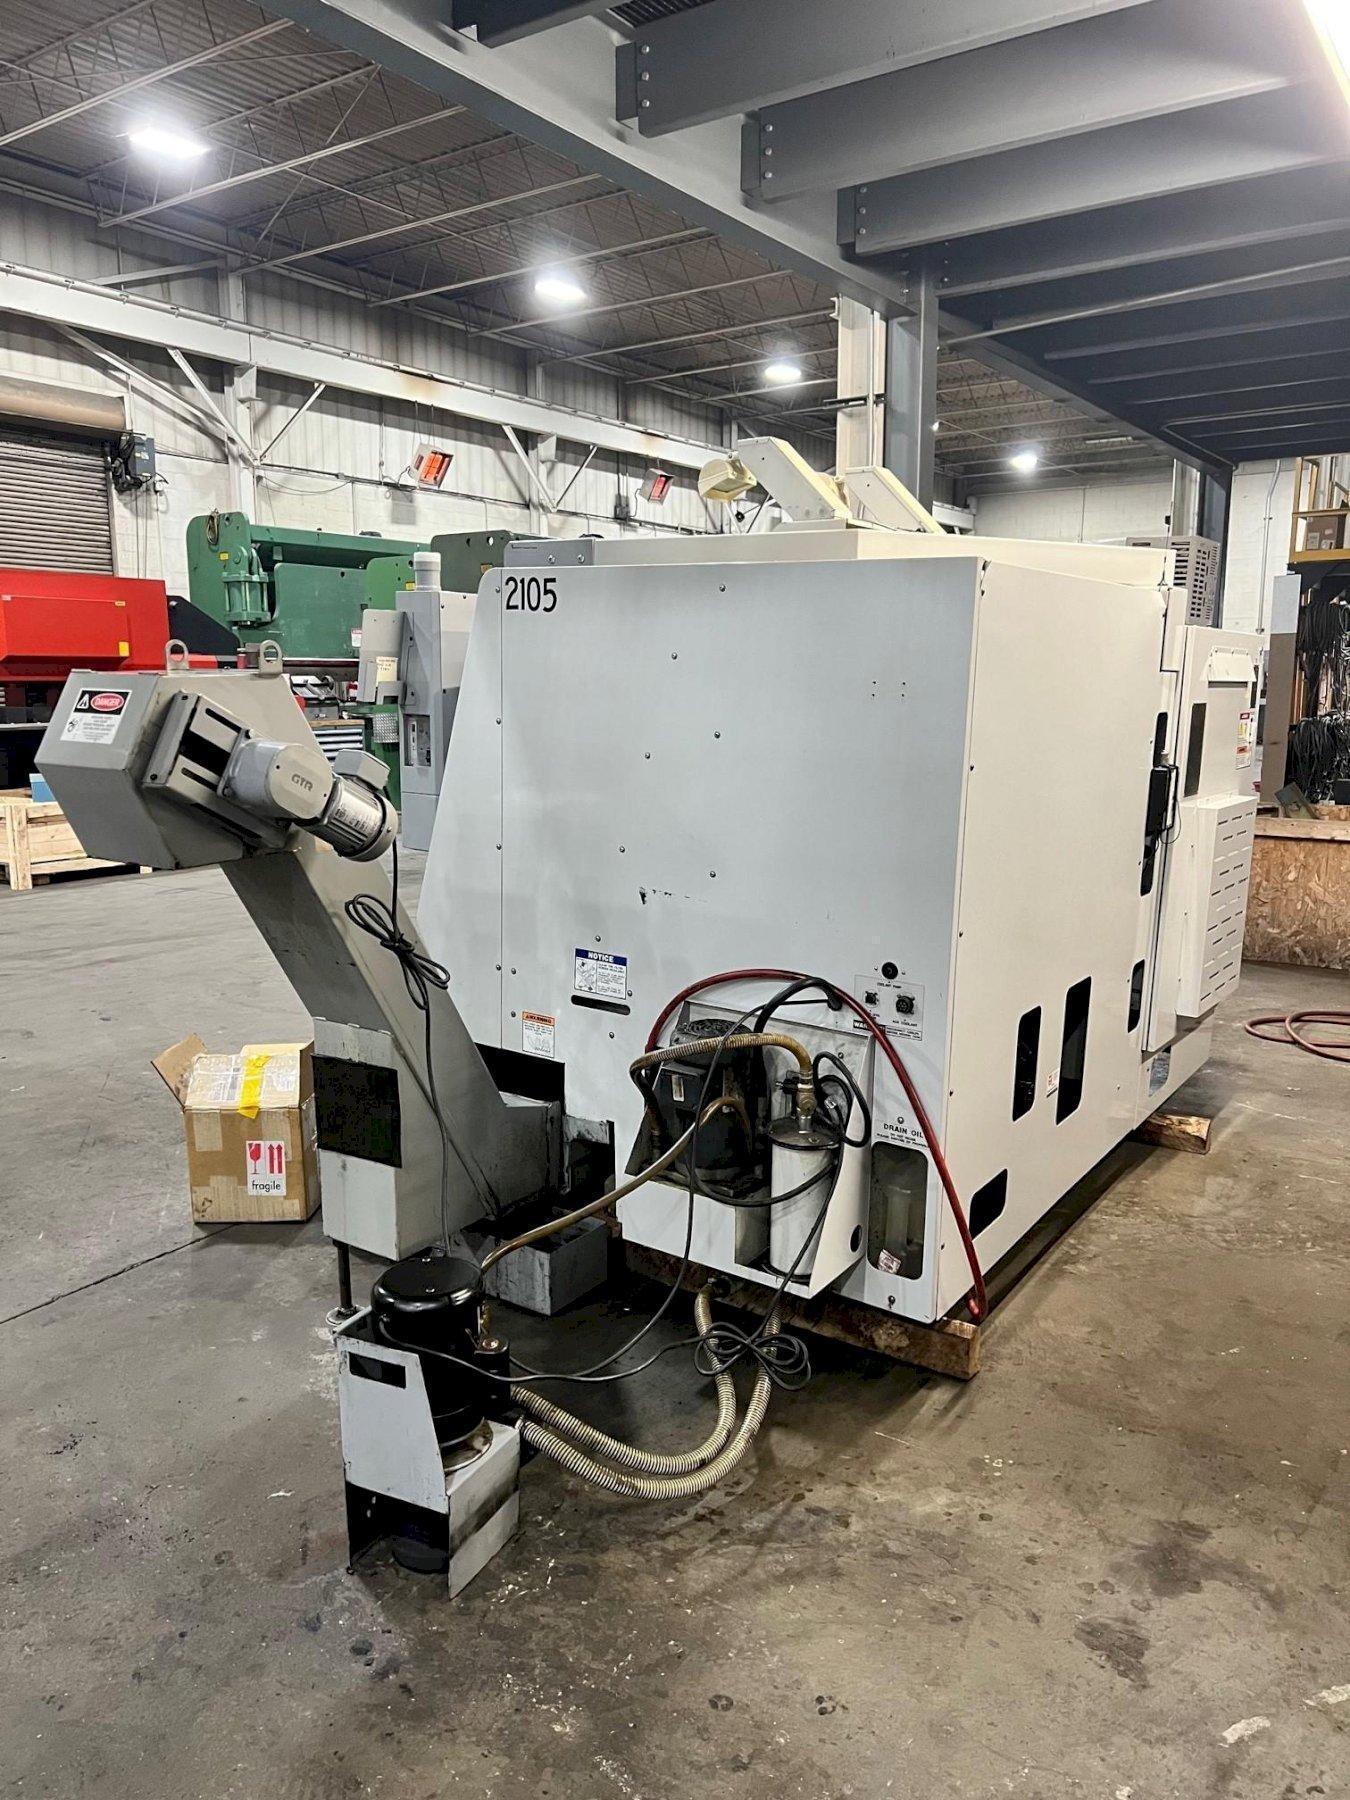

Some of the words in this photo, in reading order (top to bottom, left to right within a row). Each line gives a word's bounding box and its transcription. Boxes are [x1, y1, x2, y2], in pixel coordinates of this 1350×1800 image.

[505, 576, 557, 613] 2105
[94, 697, 121, 707] DANGER
[291, 773, 314, 792] GTR
[587, 951, 614, 963] NOTICE
[883, 1123, 908, 1134] DRAIN
[911, 1130, 924, 1139] OIL
[252, 1180, 281, 1192] fragile
